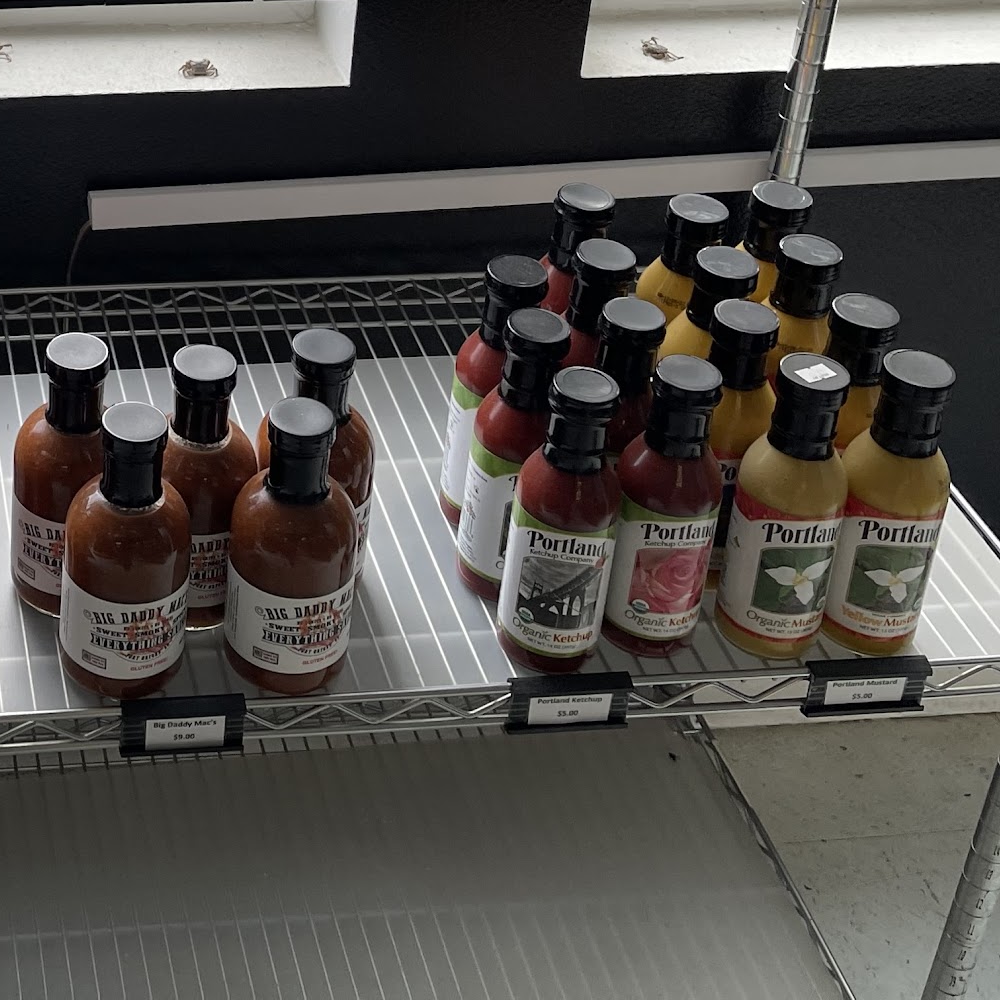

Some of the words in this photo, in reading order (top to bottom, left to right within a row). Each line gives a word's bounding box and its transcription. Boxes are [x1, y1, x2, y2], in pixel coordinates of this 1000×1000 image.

[24, 522, 41, 538] BIG
[527, 530, 607, 558] Portland
[645, 540, 676, 548] Ketchup
[530, 548, 559, 560] Ketchup
[560, 553, 594, 565] Company
[92, 611, 115, 625] BIG
[121, 605, 165, 623] DADDY
[265, 607, 288, 620] BIG
[294, 598, 336, 618] DADDY
[625, 609, 667, 627] Organic
[746, 609, 791, 628] Organic
[841, 604, 883, 627] Yellow
[96, 626, 129, 638] SWEET
[135, 626, 164, 638] SMOKY
[262, 625, 339, 645] EVERYTHING
[268, 622, 300, 632] SWEET
[512, 616, 552, 641] Organic
[553, 630, 593, 643] Ketchup
[91, 631, 165, 651] EVERYTHING
[173, 733, 195, 741] $9.00
